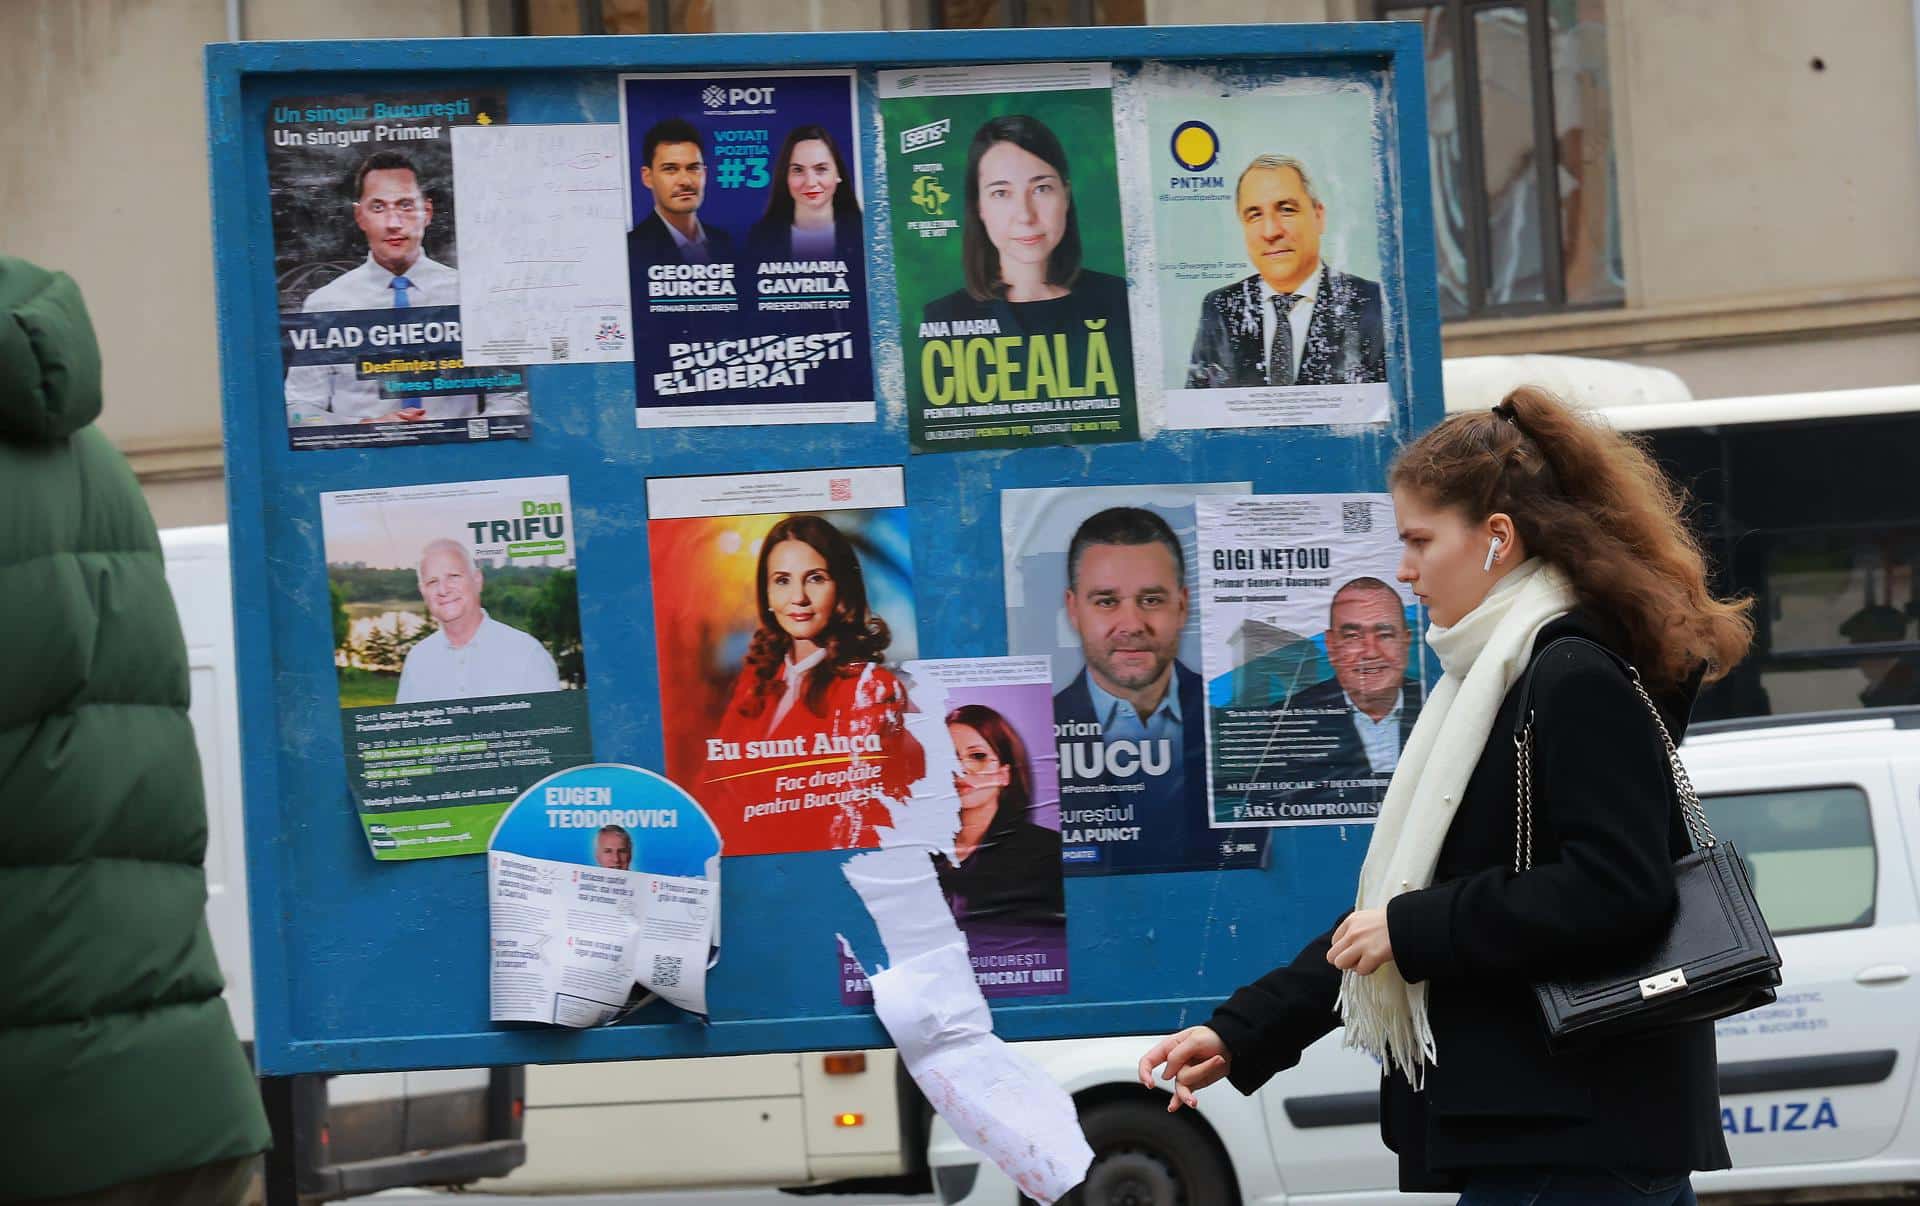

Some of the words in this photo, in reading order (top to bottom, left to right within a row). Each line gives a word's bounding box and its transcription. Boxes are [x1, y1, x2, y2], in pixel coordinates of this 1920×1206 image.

[730, 88, 775, 105] POT
[274, 106, 300, 123] Un
[305, 105, 369, 125] singur
[373, 98, 470, 121] București
[274, 129, 302, 146] Un
[306, 128, 370, 148] singur
[375, 123, 442, 142] Primar
[716, 158, 770, 188] #3
[648, 264, 735, 280] GEORGE
[757, 261, 848, 274] ANAMARIA
[648, 280, 736, 297] BURCEA
[758, 275, 849, 294] GAVRILĂ
[650, 304, 686, 313] PRIMAR
[828, 300, 851, 310] POT
[289, 326, 364, 350] VLAD
[369, 322, 460, 345] GHEOR
[919, 322, 949, 338] ANA
[951, 319, 1000, 336] MARIA
[668, 332, 854, 370] BUCUREȘTI
[920, 319, 1119, 406] CICEALĂ
[522, 500, 563, 517] Dan
[468, 516, 564, 545] TRIFU
[1213, 548, 1254, 571] GIGI
[1261, 547, 1330, 575] NEȚOIU
[706, 738, 741, 761] Eu
[745, 735, 808, 759] sunt
[812, 732, 882, 755] Anca
[1056, 739, 1171, 779] IUCU
[775, 776, 805, 793] Fac
[809, 764, 882, 788] dreptate
[1273, 781, 1314, 790] LOCALE
[545, 787, 611, 806] EUGEN
[546, 809, 678, 828] TEODOROVICI
[743, 797, 801, 822] pentru
[1233, 803, 1276, 818] FĂRĂ
[1084, 827, 1142, 842] PUNCT
